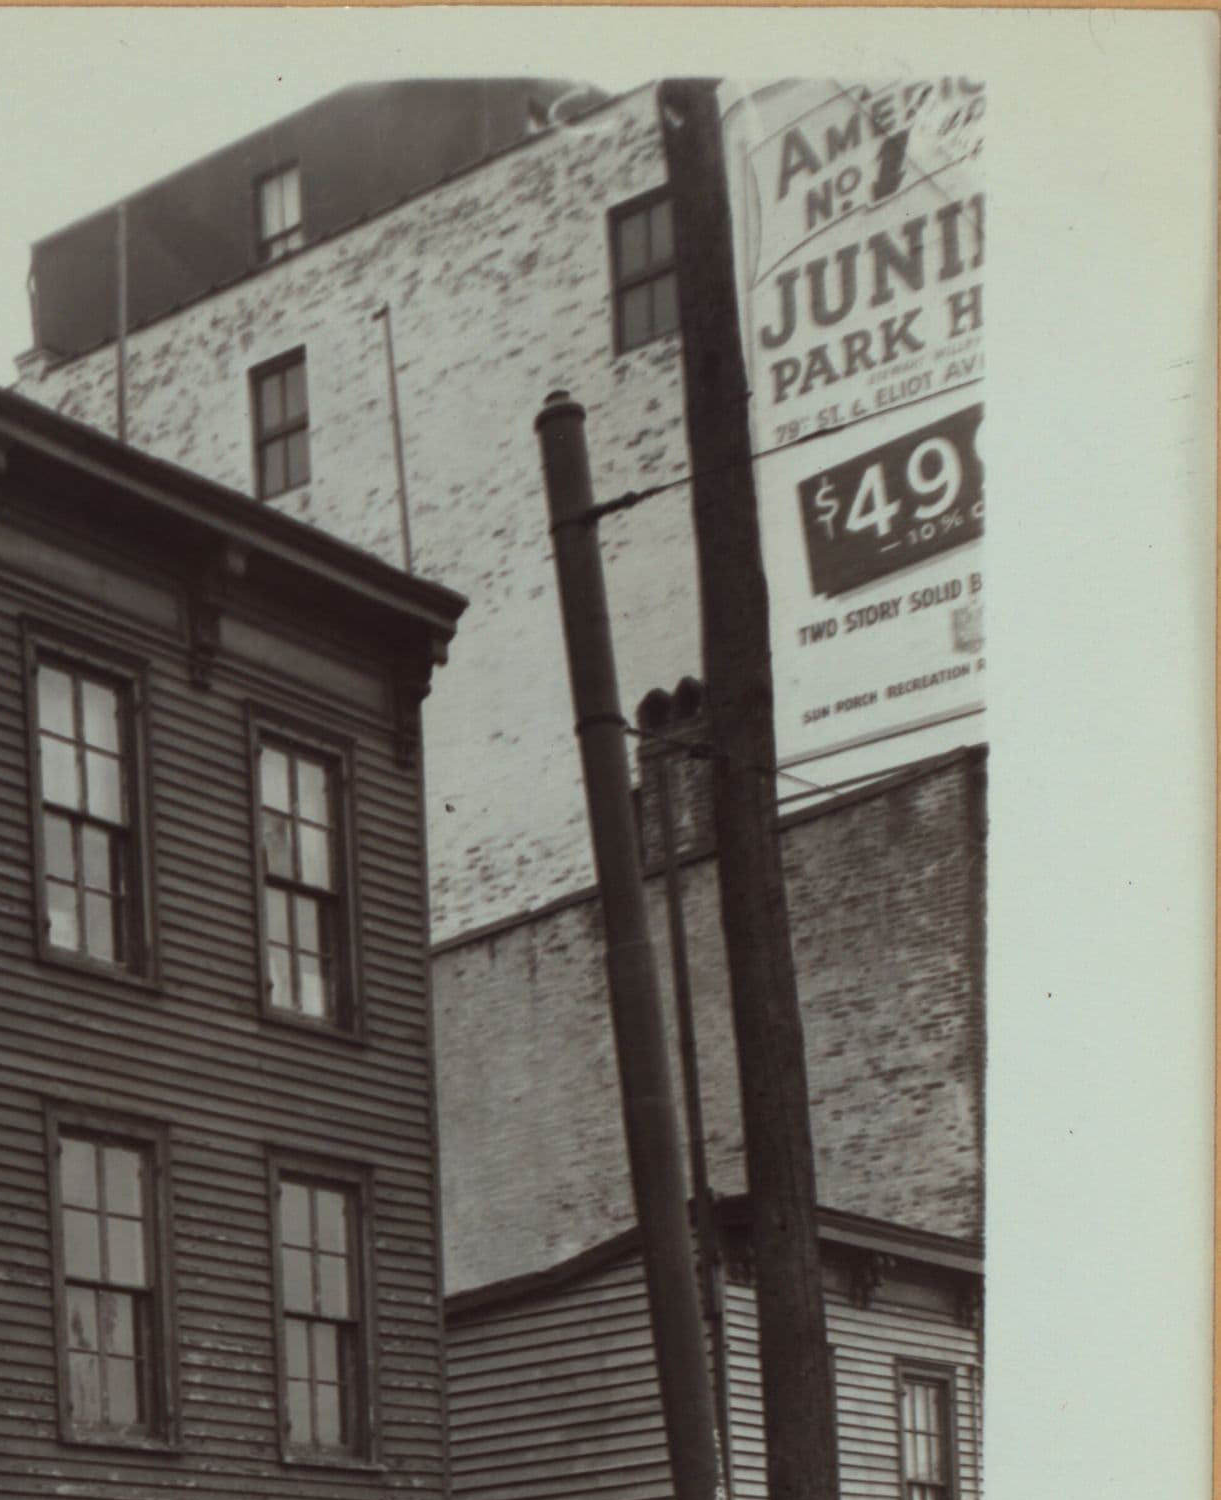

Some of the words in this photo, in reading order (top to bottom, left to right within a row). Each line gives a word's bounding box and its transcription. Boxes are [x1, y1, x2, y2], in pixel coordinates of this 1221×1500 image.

[871, 127, 910, 201] 1
[769, 306, 925, 406] PARK
[945, 283, 984, 340] H
[874, 370, 933, 408] ELIOT
[814, 417, 984, 540] $49
[798, 617, 838, 647] TWO
[844, 596, 903, 634] STORY
[909, 579, 963, 614] SOLID
[802, 706, 830, 727] SUN
[834, 690, 878, 714] PORCH
[885, 663, 970, 700] RECREATION
